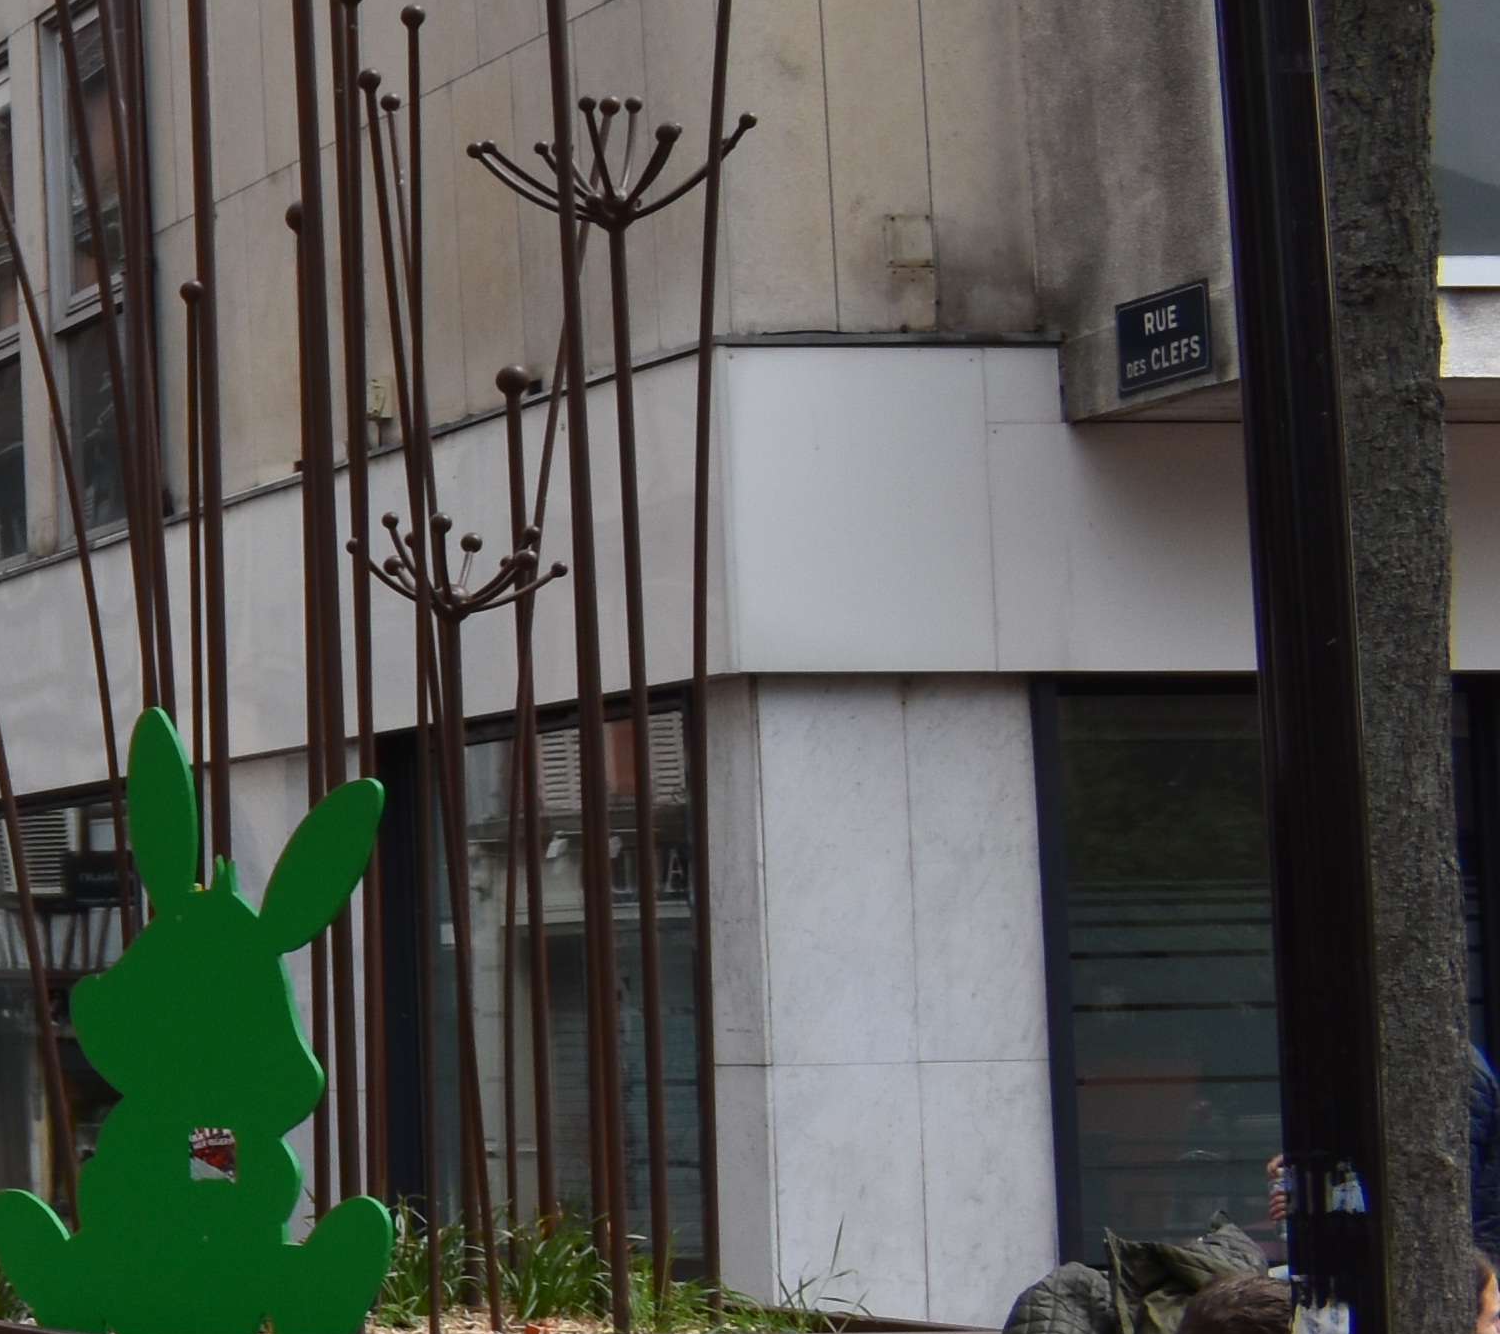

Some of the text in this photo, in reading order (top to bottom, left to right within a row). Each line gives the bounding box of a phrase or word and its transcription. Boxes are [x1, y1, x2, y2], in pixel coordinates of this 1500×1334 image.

[1144, 305, 1178, 336] RUE
[1126, 335, 1200, 379] DES CLEFS
